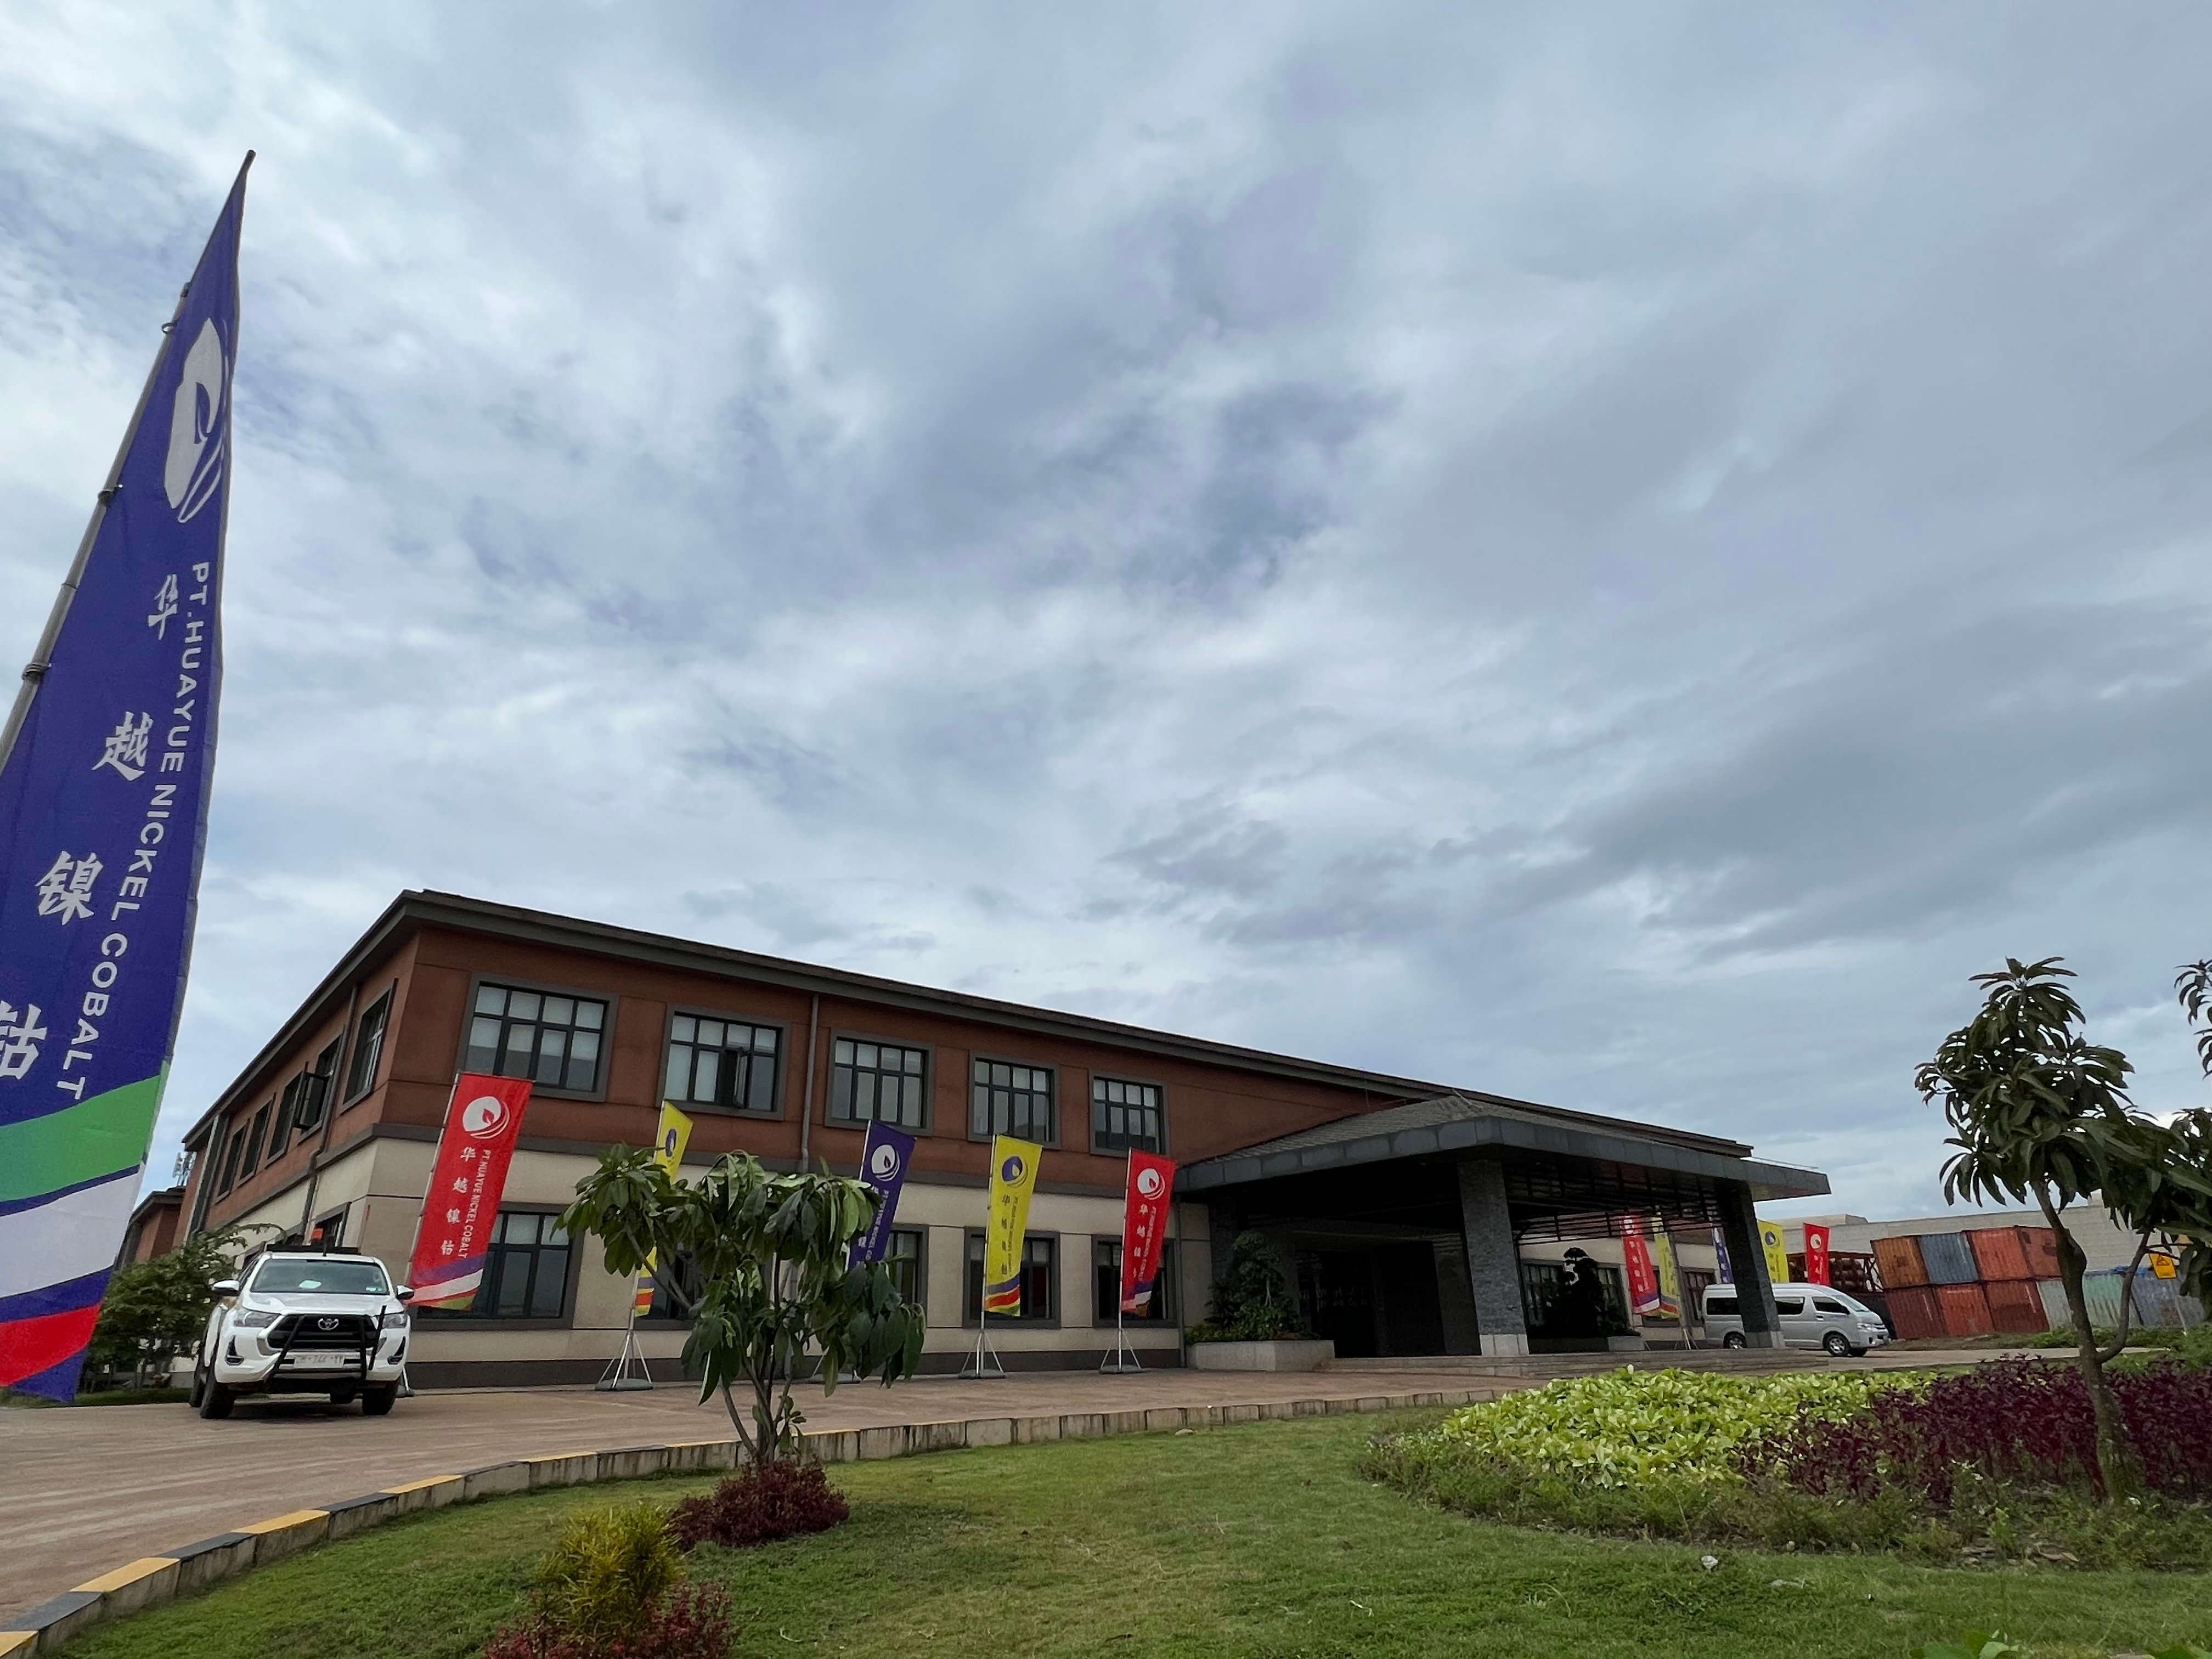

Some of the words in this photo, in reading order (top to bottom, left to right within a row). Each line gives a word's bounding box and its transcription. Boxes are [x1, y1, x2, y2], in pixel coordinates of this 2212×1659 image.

[161, 562, 210, 772] PT.HUAYUE
[111, 785, 177, 920] NICKEL
[57, 933, 128, 1099] COBALT
[458, 1225, 473, 1259] COBALT
